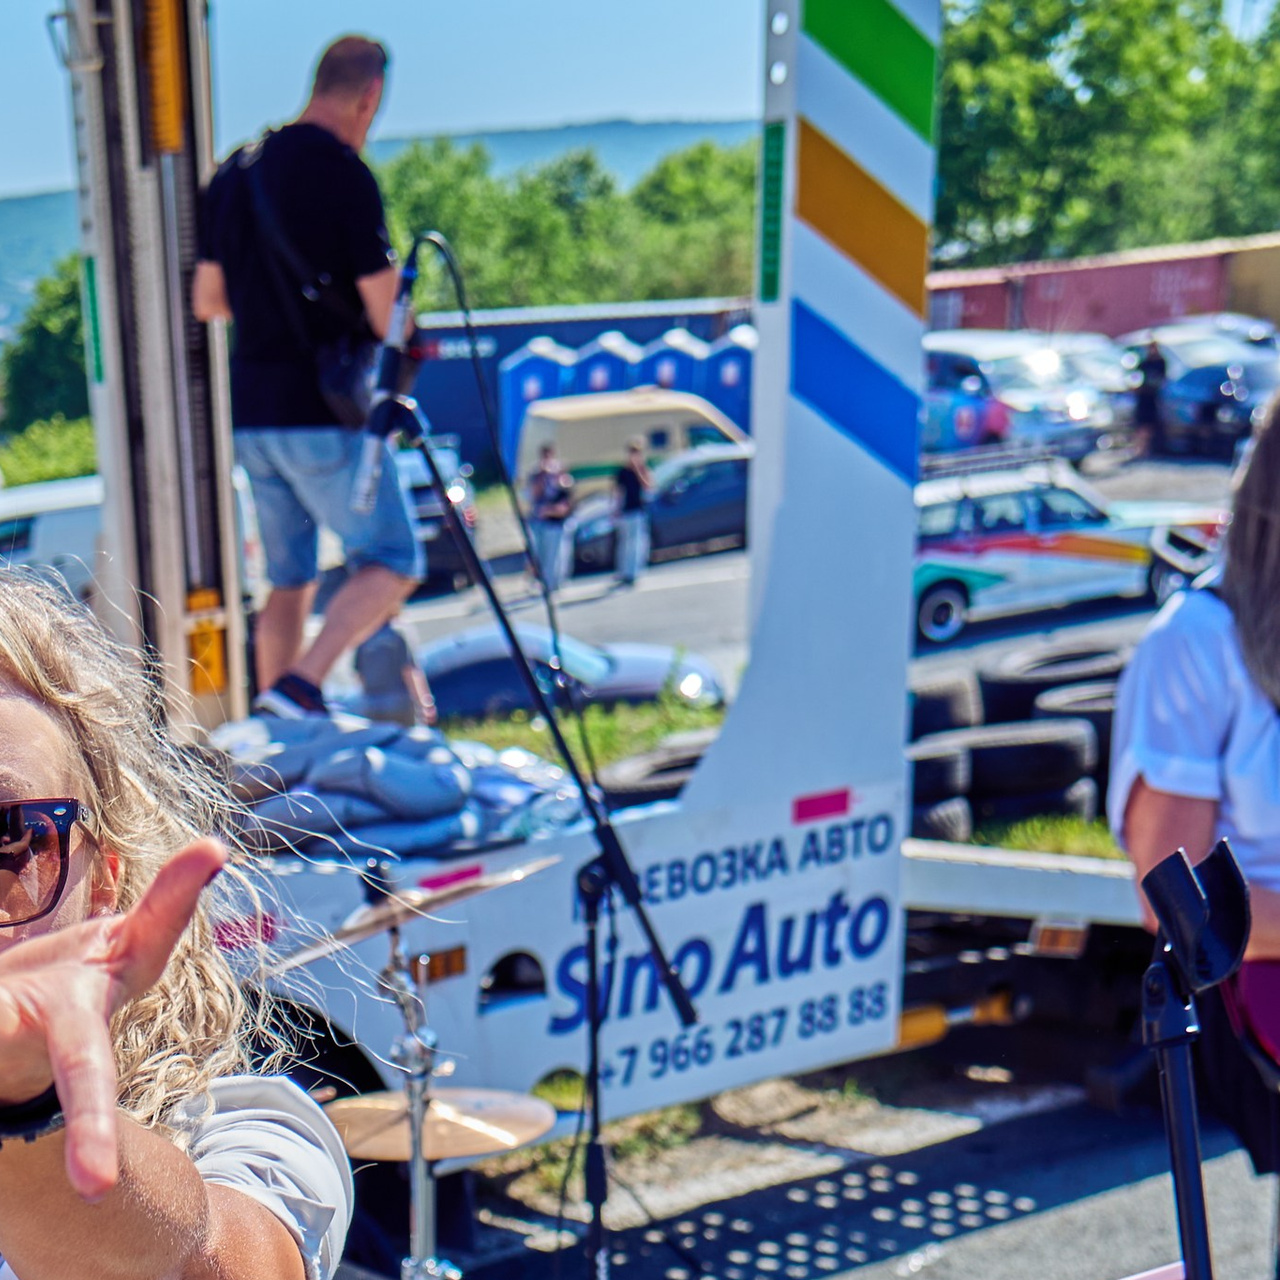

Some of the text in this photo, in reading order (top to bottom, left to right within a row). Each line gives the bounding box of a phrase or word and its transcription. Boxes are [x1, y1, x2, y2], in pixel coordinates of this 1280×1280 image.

[799, 815, 894, 873] АВТО
[718, 889, 891, 995] Auto
[598, 981, 889, 1089] +7 966 287 88 88
